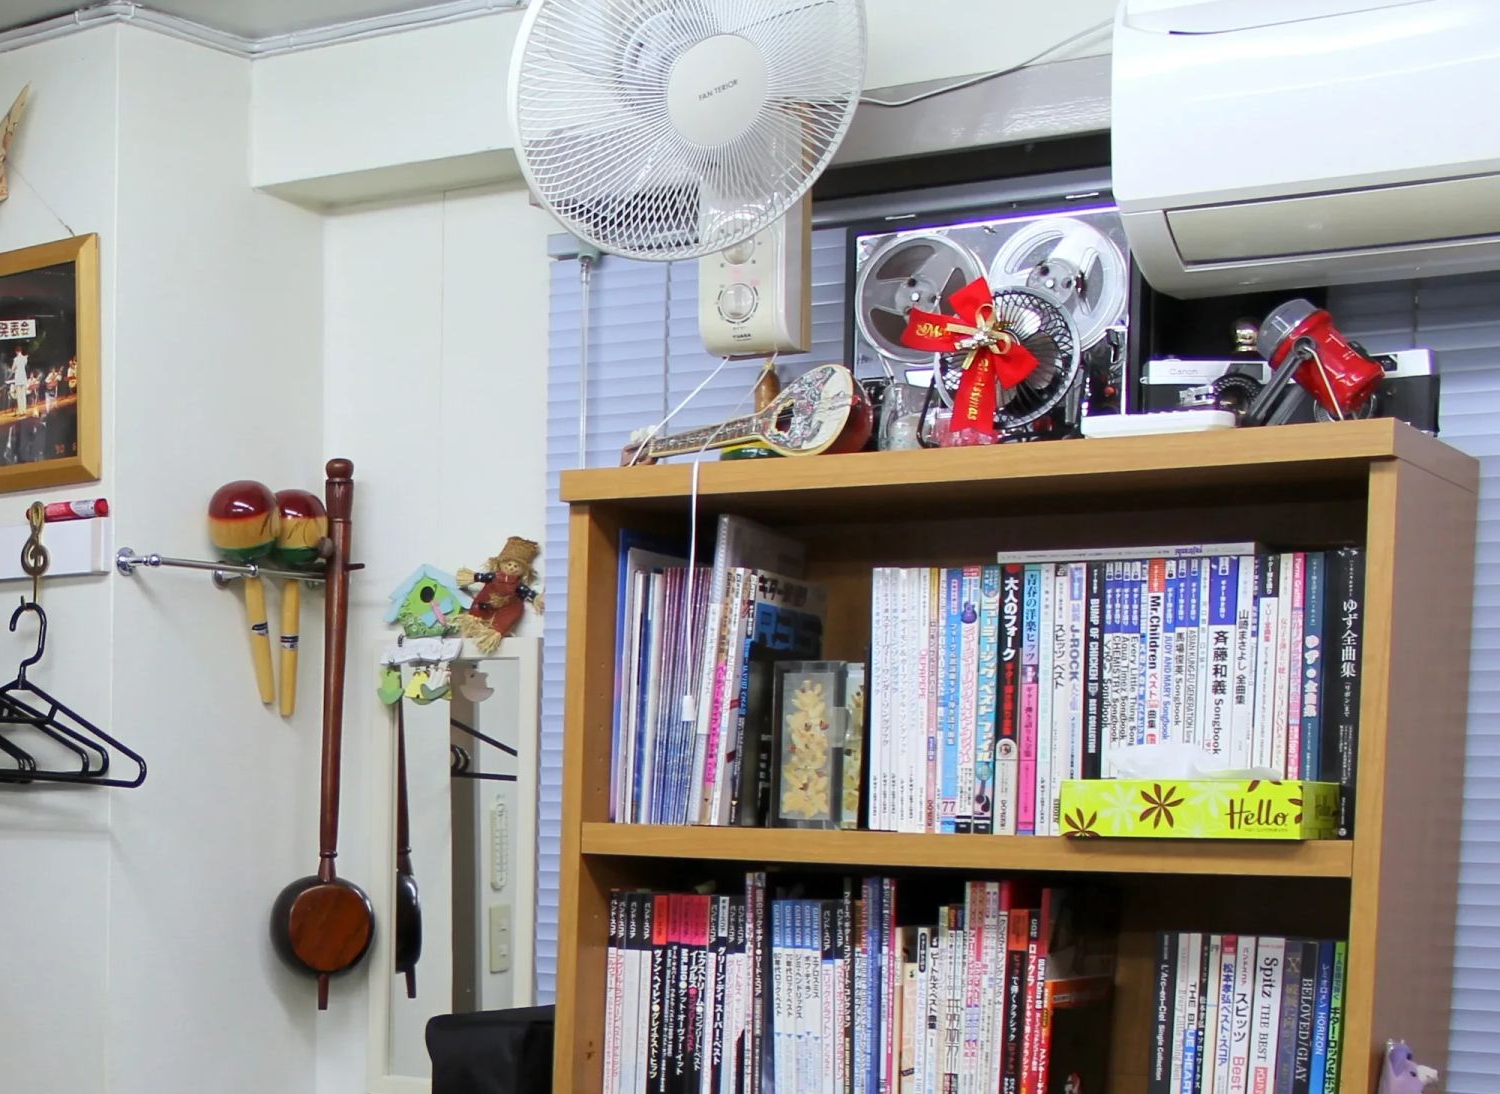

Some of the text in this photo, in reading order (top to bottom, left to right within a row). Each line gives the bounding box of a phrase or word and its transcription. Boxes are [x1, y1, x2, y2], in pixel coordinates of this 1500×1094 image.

[699, 90, 713, 102] FAN
[1002, 576, 1019, 662] 大人のフォーク
[1148, 595, 1161, 669] Mr.Children
[1237, 609, 1249, 671] 山崎まさよし
[1340, 600, 1359, 678] ゆず全曲集
[1054, 624, 1066, 690] スピッツ ベスト
[1069, 625, 1080, 681] J-ROCK
[1087, 599, 1100, 753] BUMP OF CHICKEN BEST COLLECTION
[1185, 628, 1196, 728] ASIAN KUNG-FU GENERATION
[1102, 678, 1112, 728] Songbook
[1111, 635, 1121, 742] CHEMISTRY Songbook
[1118, 636, 1130, 740] Aqua Timez Songbook
[1127, 635, 1139, 747] Every Little Thing Song
[1160, 635, 1173, 740] JUDY AND MARY Songbook
[1173, 678, 1183, 726] Songbook
[1212, 631, 1229, 756] 斉藤和義 Songbook
[942, 801, 956, 812] 77
[1225, 798, 1289, 831] Hello
[812, 956, 821, 999] エアロスミス
[1188, 981, 1198, 1008] THE
[1257, 957, 1278, 1063] Spitz THE BEST
[1154, 964, 1169, 1081] L'Arc-en-Ciel Single Collection
[1185, 1013, 1197, 1047] BLUE
[1233, 993, 1249, 1043] スピッツ
[1295, 978, 1313, 1083] BELOVED/GLAY
[1315, 1011, 1329, 1056] HORIZON
[1231, 1056, 1247, 1091] Best
